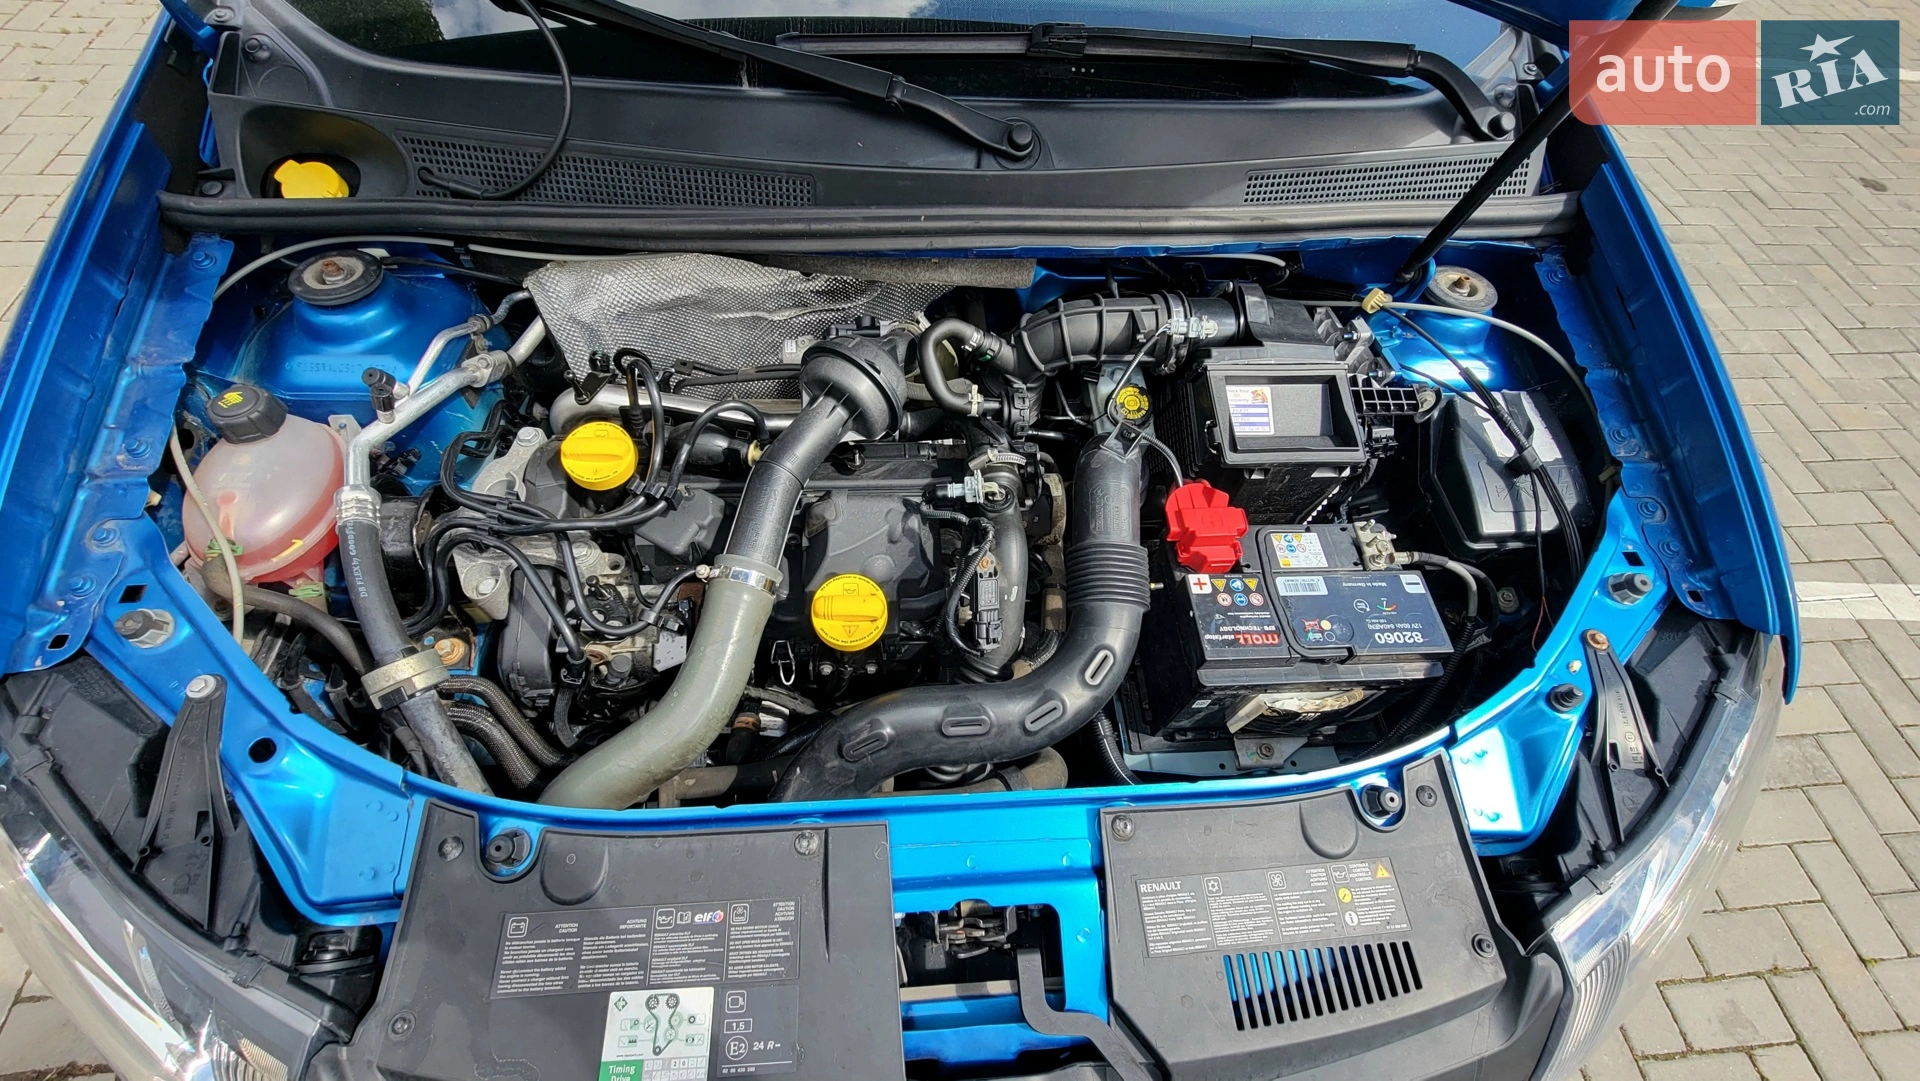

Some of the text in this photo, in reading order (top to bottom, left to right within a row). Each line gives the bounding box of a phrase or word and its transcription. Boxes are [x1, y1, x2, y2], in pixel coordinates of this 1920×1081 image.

[353, 566, 364, 585] FLEX
[358, 587, 368, 597] DB
[1374, 631, 1423, 644] 82060
[1140, 881, 1181, 893] RENAULT
[694, 912, 712, 922] elf
[732, 1022, 745, 1032] 1,5
[730, 1042, 745, 1056] E2
[753, 1041, 764, 1051] 24
[609, 1064, 635, 1074] Timing
